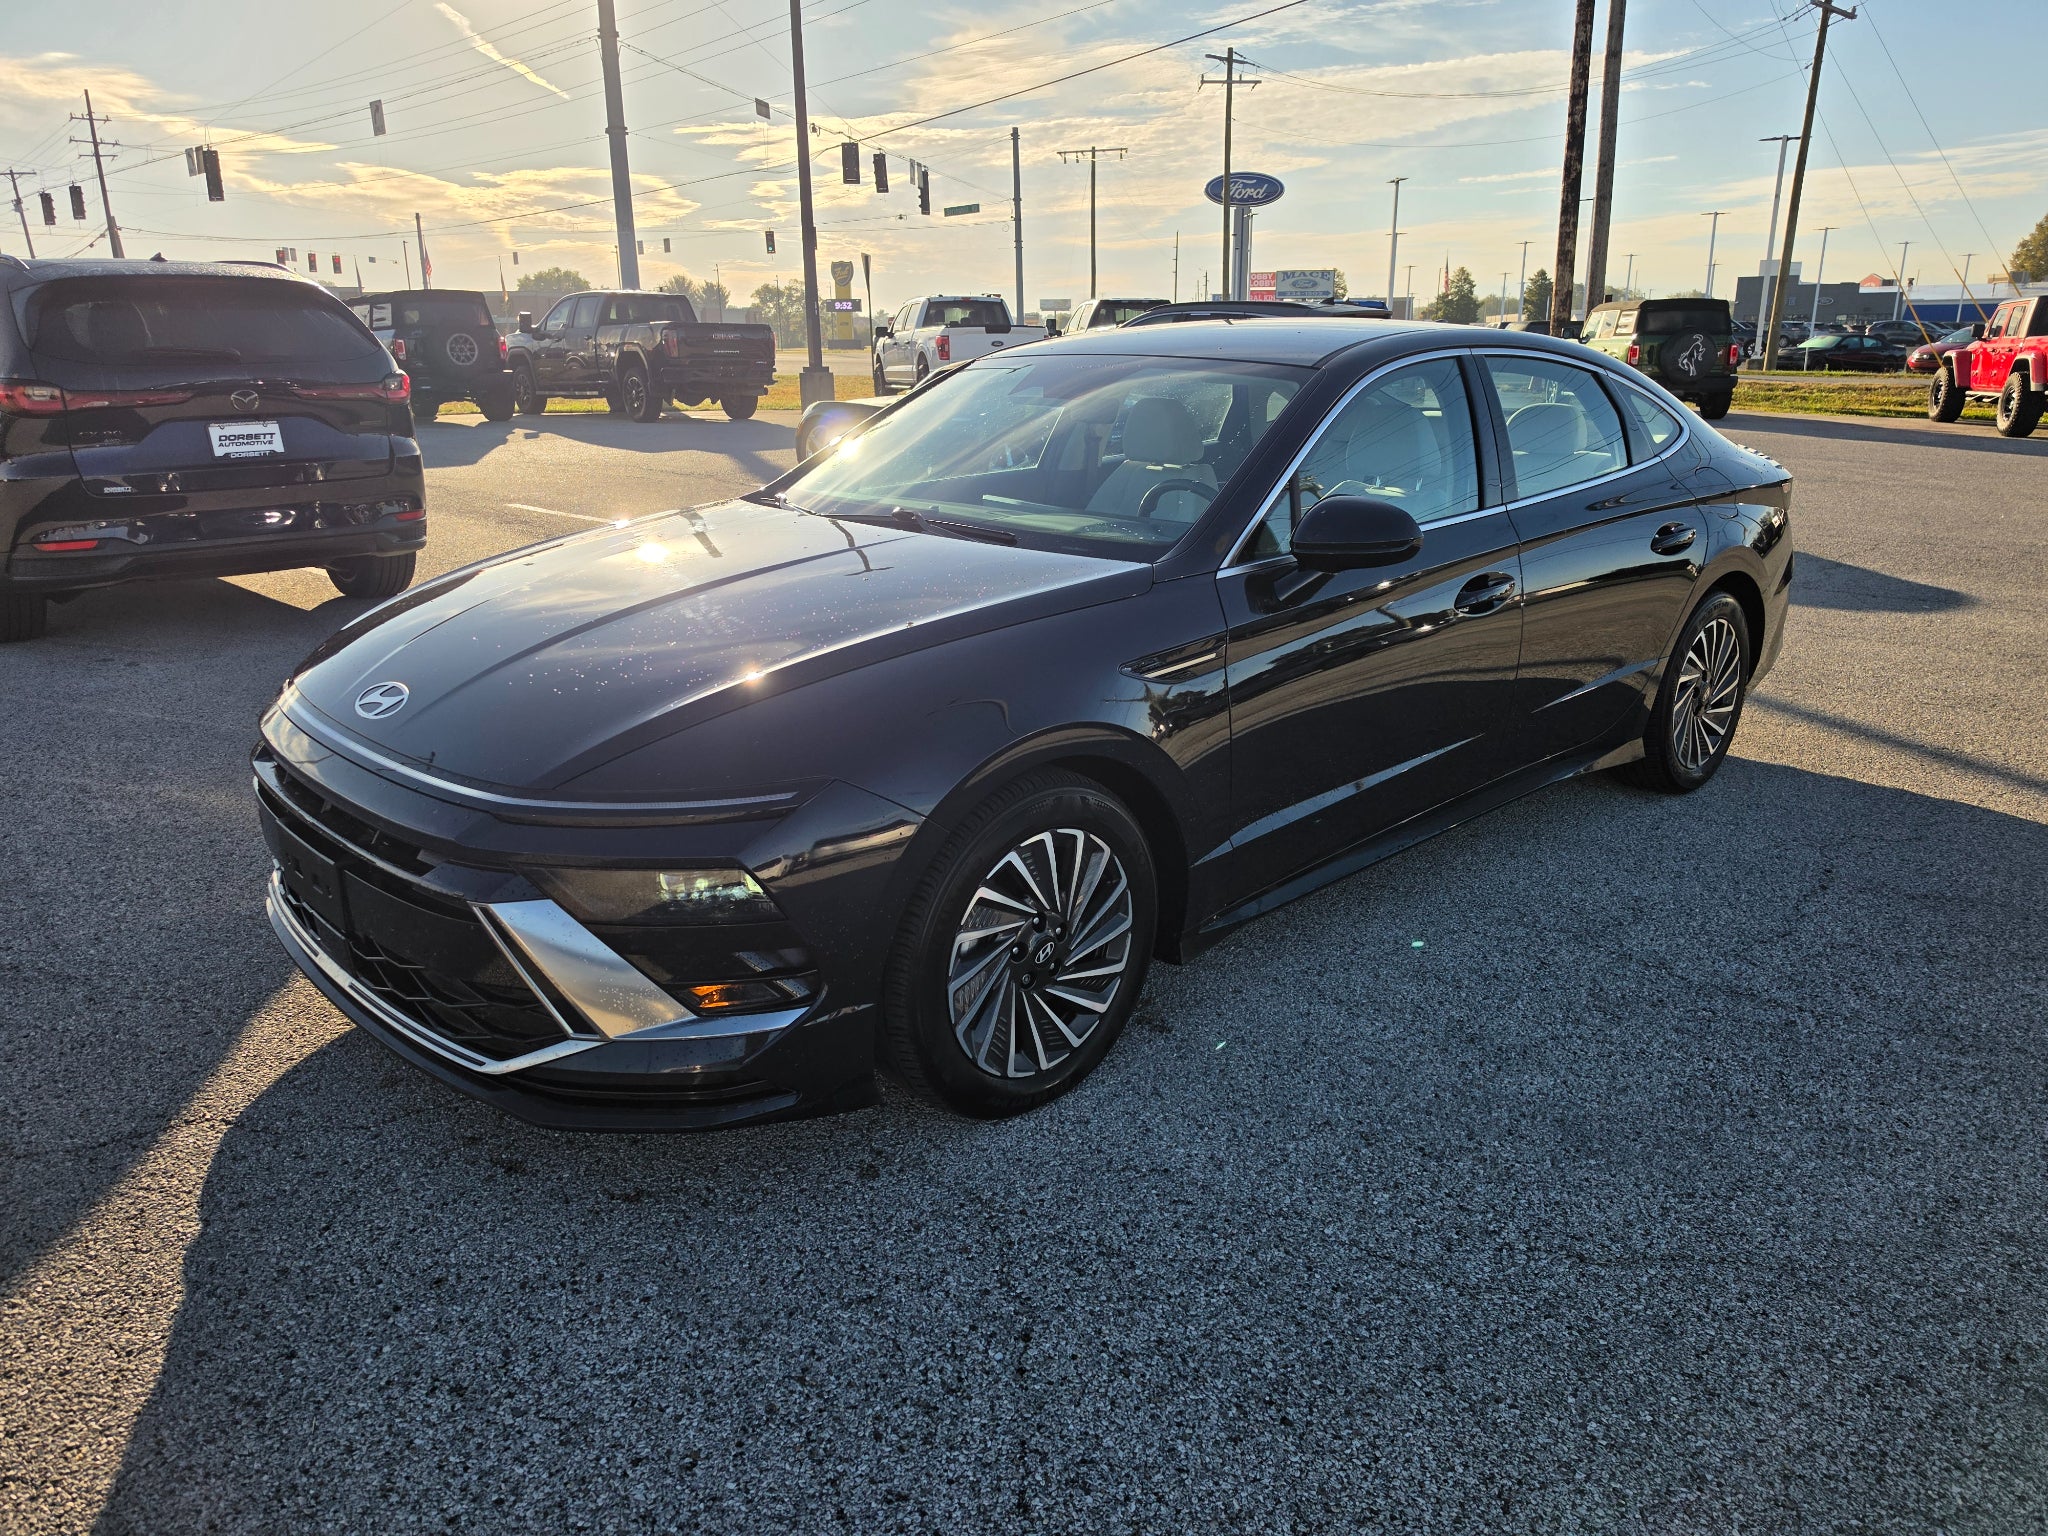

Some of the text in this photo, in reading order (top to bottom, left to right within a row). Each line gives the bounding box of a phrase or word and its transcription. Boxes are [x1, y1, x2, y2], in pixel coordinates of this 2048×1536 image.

[1221, 178, 1268, 199] Ford
[1250, 272, 1273, 280] OBBY
[1281, 271, 1331, 281] MACE
[834, 301, 853, 310] 9:32
[218, 432, 276, 442] DORSETT
[218, 440, 274, 448] AUTOMOTIVE
